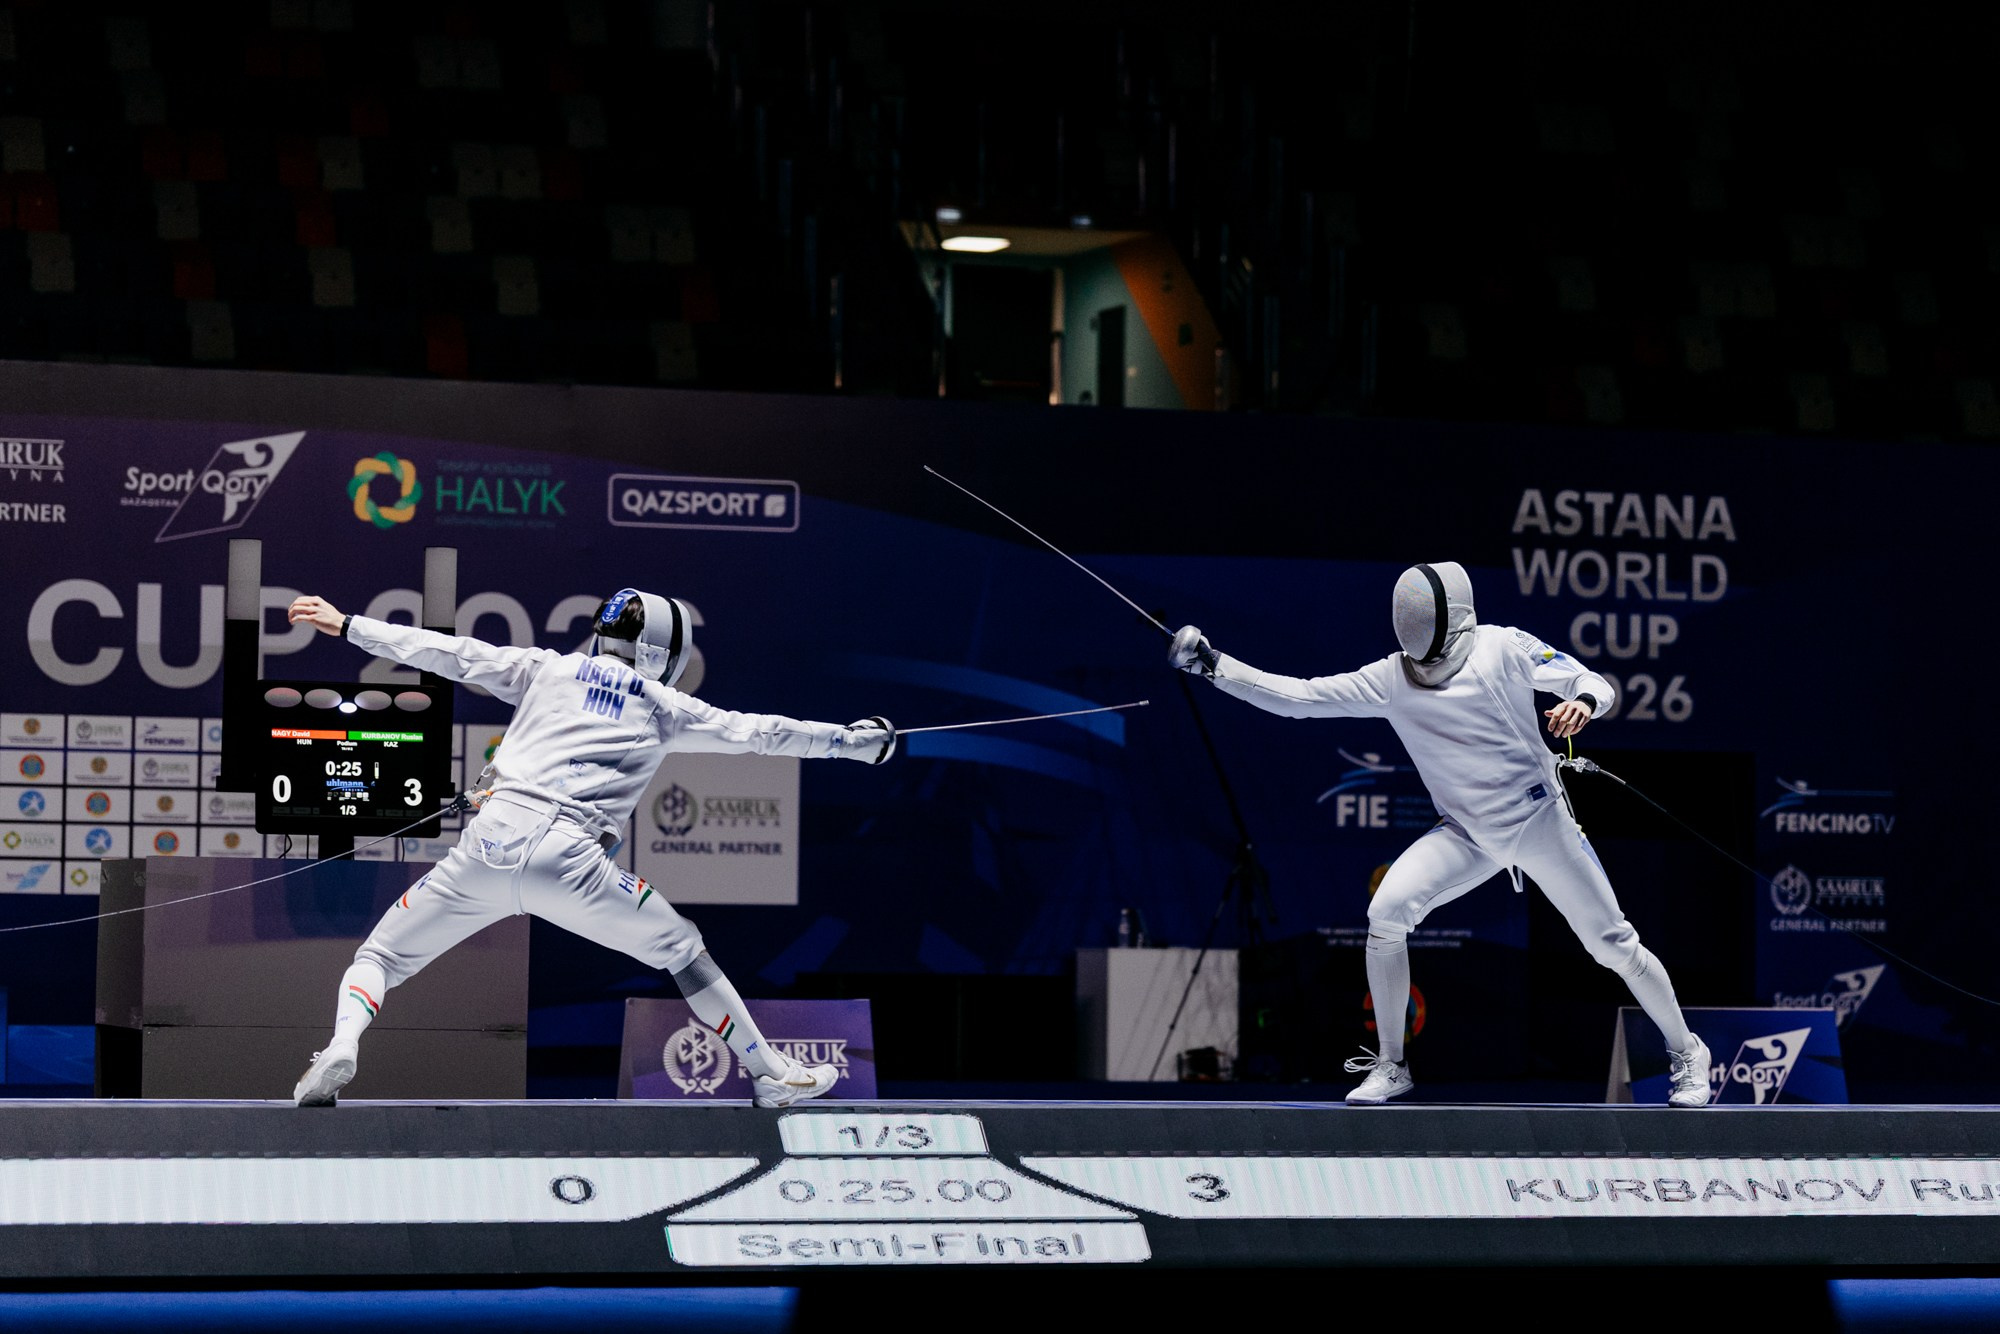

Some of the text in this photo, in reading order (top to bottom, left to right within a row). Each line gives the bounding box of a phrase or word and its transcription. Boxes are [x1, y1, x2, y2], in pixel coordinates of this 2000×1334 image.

[124, 466, 268, 501] Sport Qory
[436, 475, 566, 515] HALYK
[622, 488, 760, 517] QAZSPORT
[1511, 488, 1738, 543] ASTANA
[1511, 547, 1729, 603] WORLD
[27, 578, 318, 689] CUP
[1568, 610, 1680, 661] CUP
[575, 658, 628, 691] NAGY
[582, 686, 626, 721] HUN
[271, 729, 311, 738] NAGY David
[361, 732, 401, 740] KURBANOV
[325, 761, 362, 776] 0:25
[326, 779, 364, 787] uhlmann
[272, 774, 292, 803] 0
[403, 778, 423, 806] 3
[339, 805, 358, 816] 1/3
[1336, 794, 1390, 829] FIE
[651, 841, 782, 855] GENERAL PARTNER
[1731, 1062, 1788, 1088] Qory
[838, 1124, 934, 1150] 1/3
[548, 1174, 597, 1205] 0
[778, 1178, 1013, 1203] 0.25.00
[1185, 1173, 1232, 1204] 3
[1506, 1177, 2000, 1203] KURBANOV Ru
[737, 1231, 1085, 1259] Semi-Final
